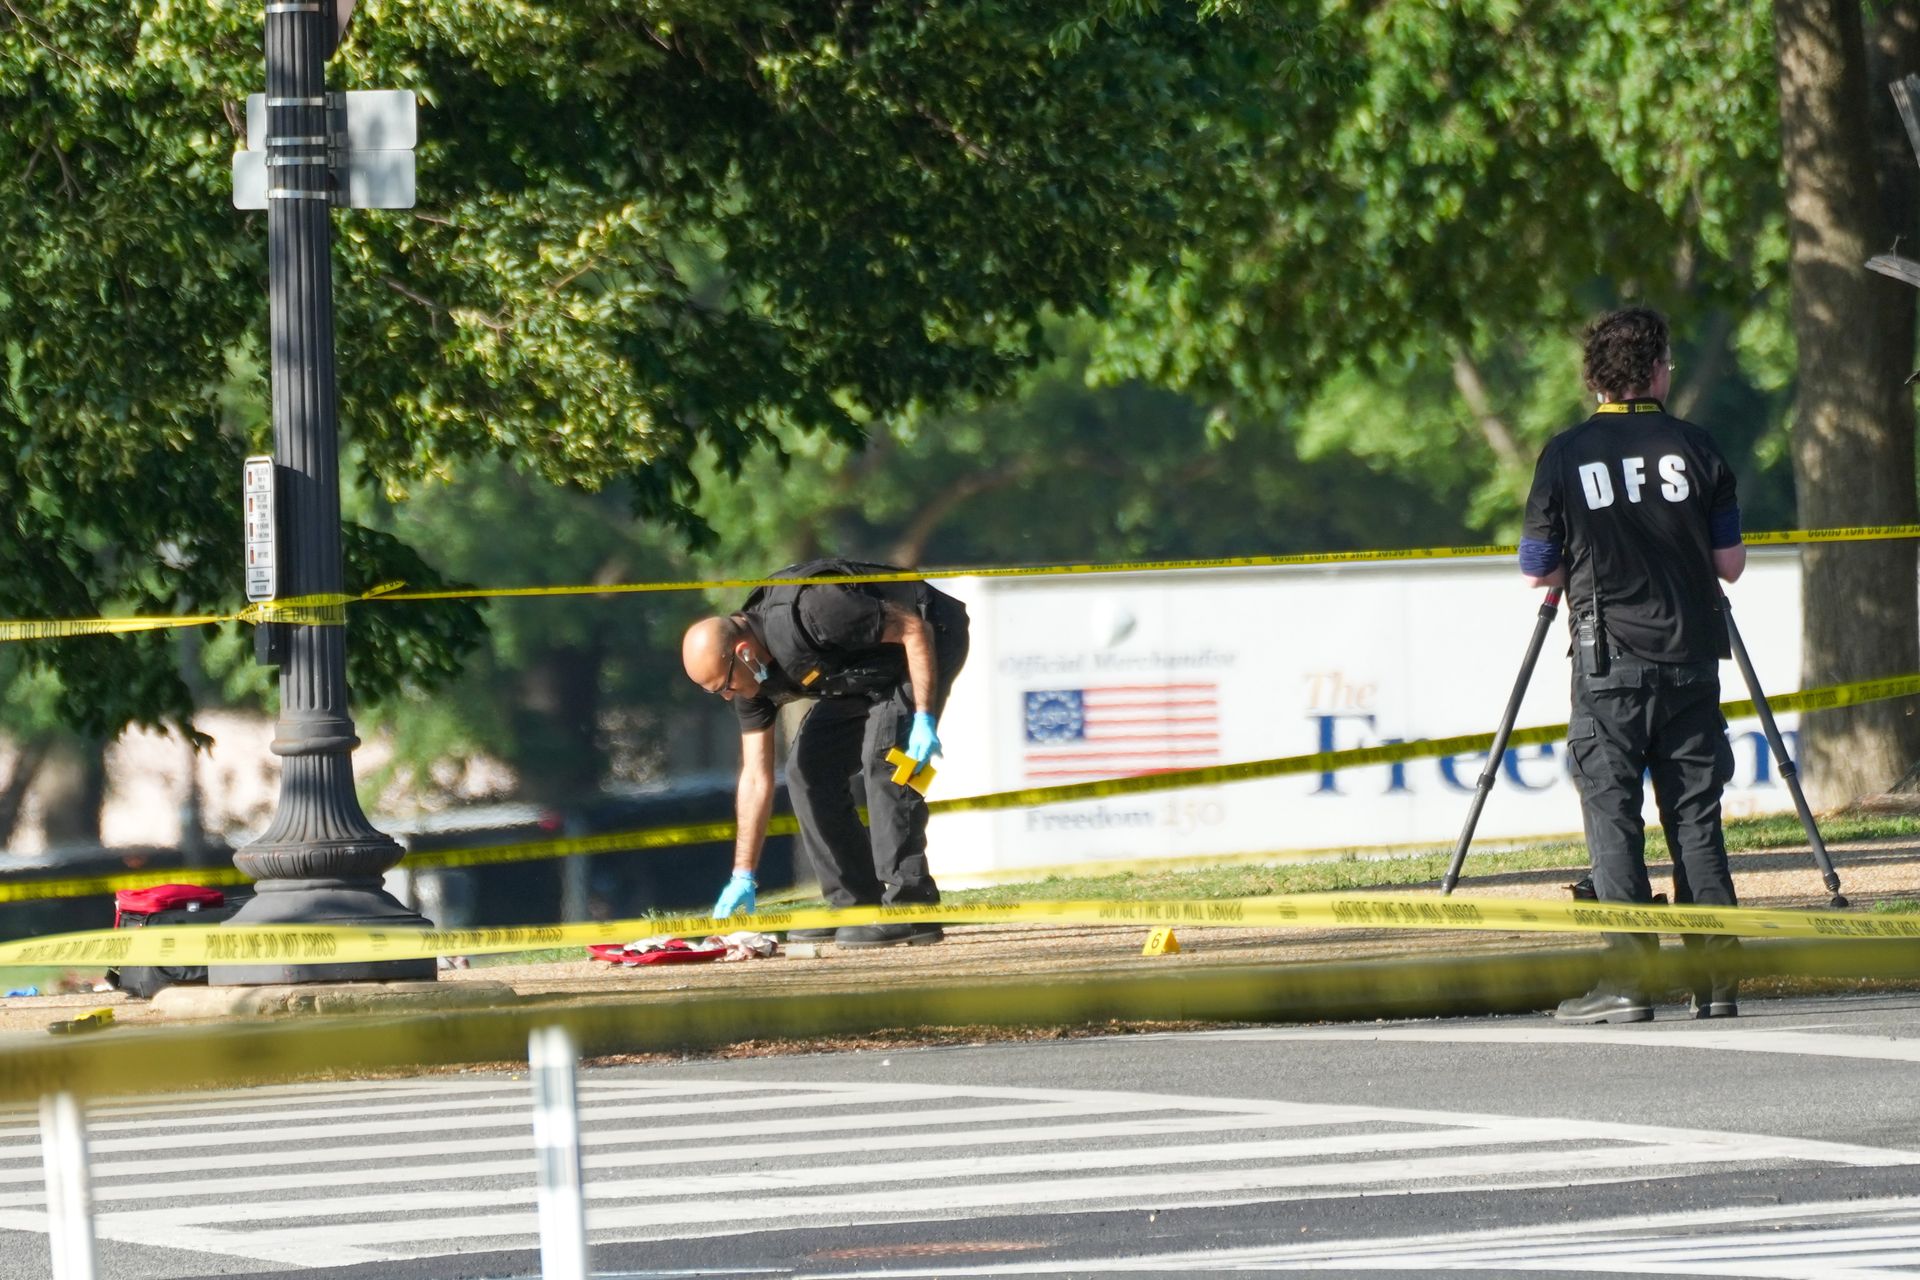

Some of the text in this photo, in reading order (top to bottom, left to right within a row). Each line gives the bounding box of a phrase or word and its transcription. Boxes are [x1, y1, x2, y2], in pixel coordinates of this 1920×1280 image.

[1578, 454, 1690, 511] DFS
[1305, 671, 1377, 710] The
[1306, 713, 1808, 796] Freem
[1025, 805, 1154, 832] Freedom
[205, 933, 238, 959] POLICE
[240, 933, 263, 959] LINE
[265, 933, 279, 959] DO
[281, 933, 300, 959] NOT
[302, 932, 338, 958] CROSS
[1151, 932, 1162, 949] 6
